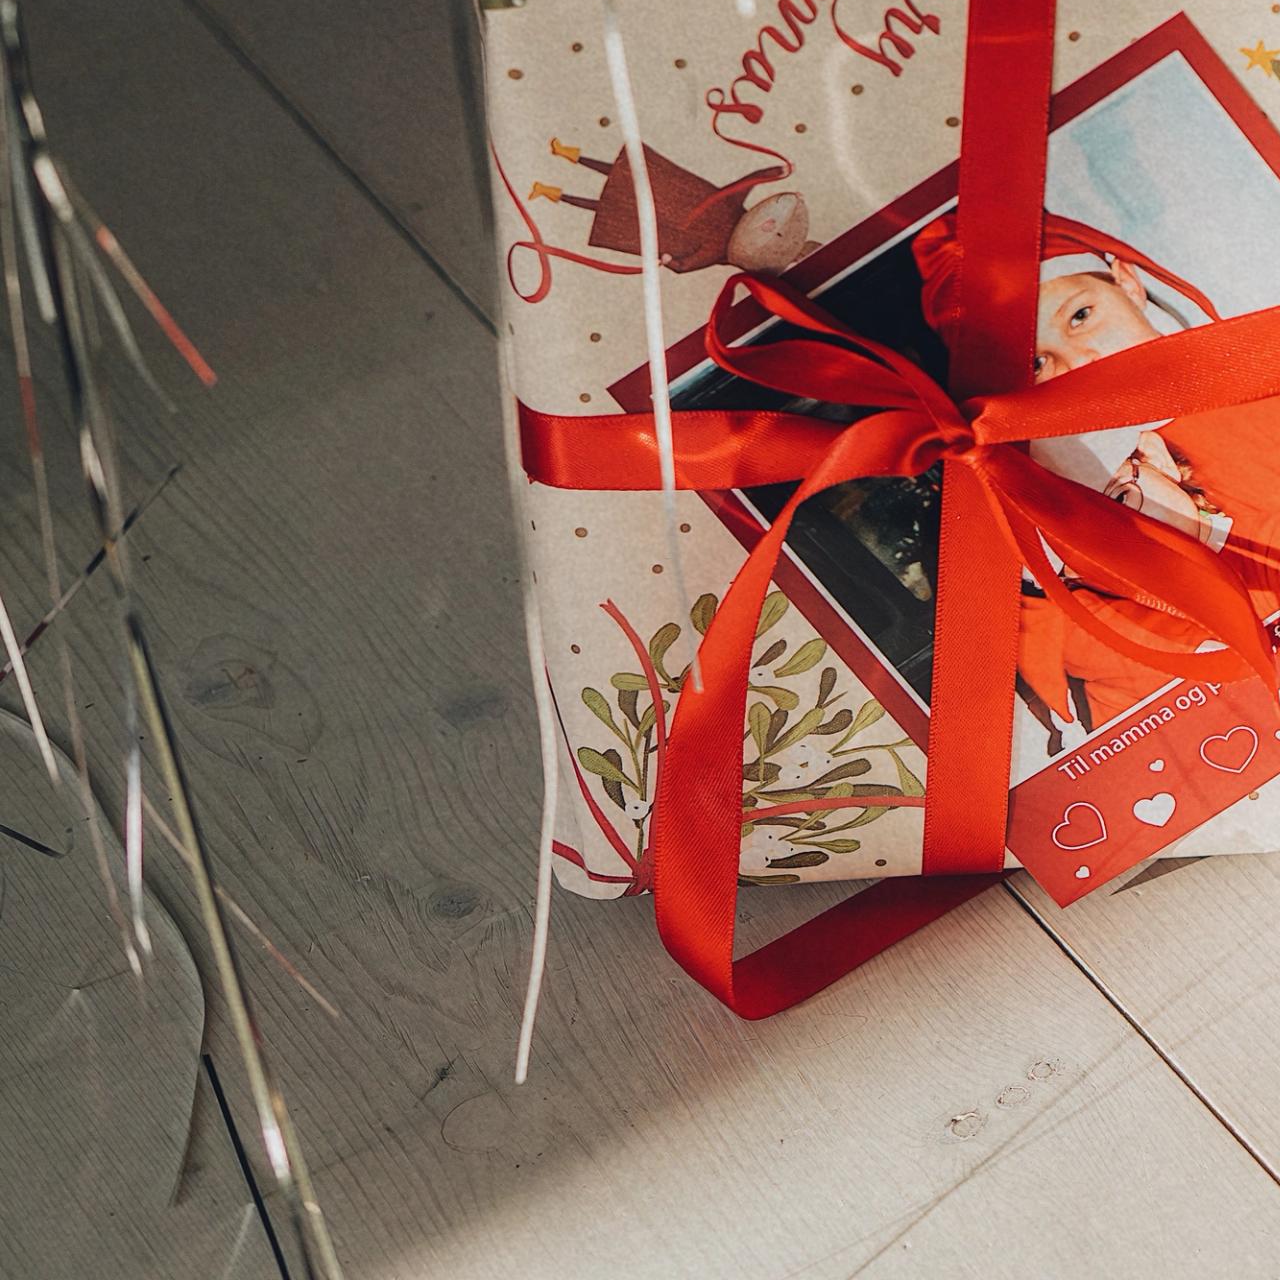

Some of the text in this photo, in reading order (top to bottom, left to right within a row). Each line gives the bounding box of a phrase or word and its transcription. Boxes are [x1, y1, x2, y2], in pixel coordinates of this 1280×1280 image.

[1057, 755, 1091, 781] Til
[1091, 706, 1176, 766] mamma
[1175, 685, 1208, 711] og
